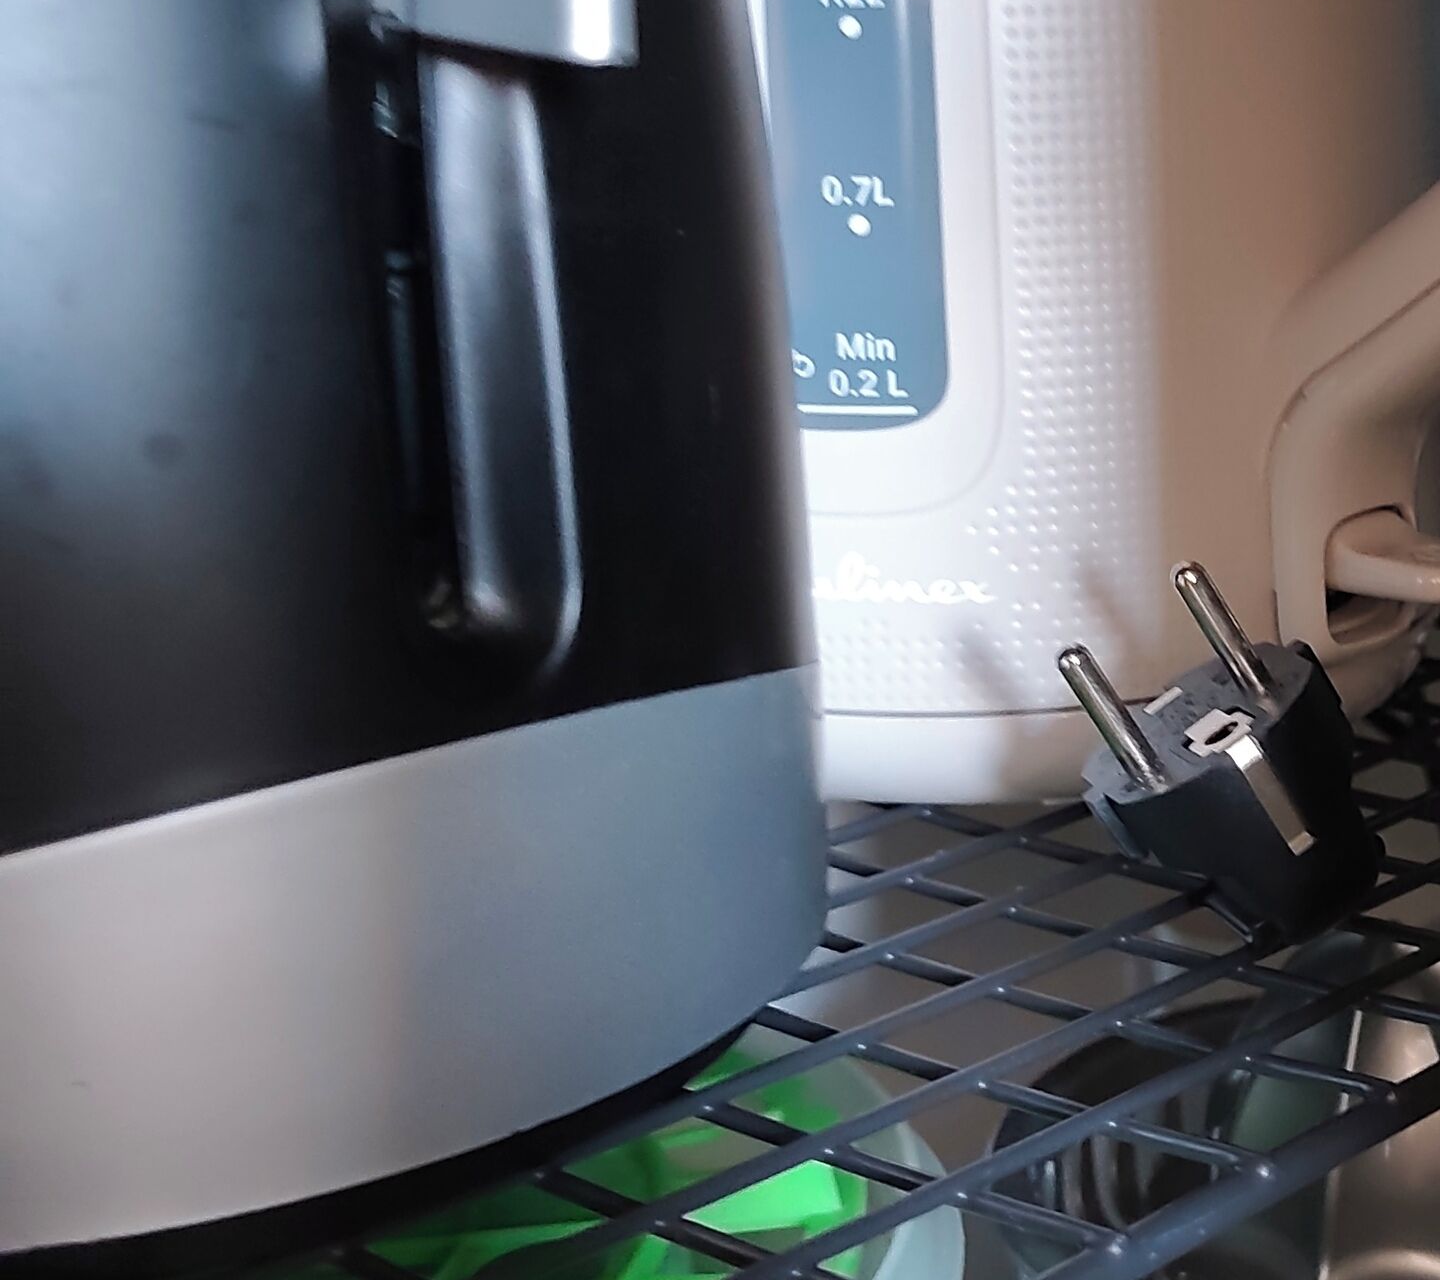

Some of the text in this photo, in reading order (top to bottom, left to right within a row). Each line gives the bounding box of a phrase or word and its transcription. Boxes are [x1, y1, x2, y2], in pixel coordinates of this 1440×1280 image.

[820, 174, 896, 207] 0.7L
[835, 332, 897, 362] Min
[828, 369, 910, 399] 0.2 L
